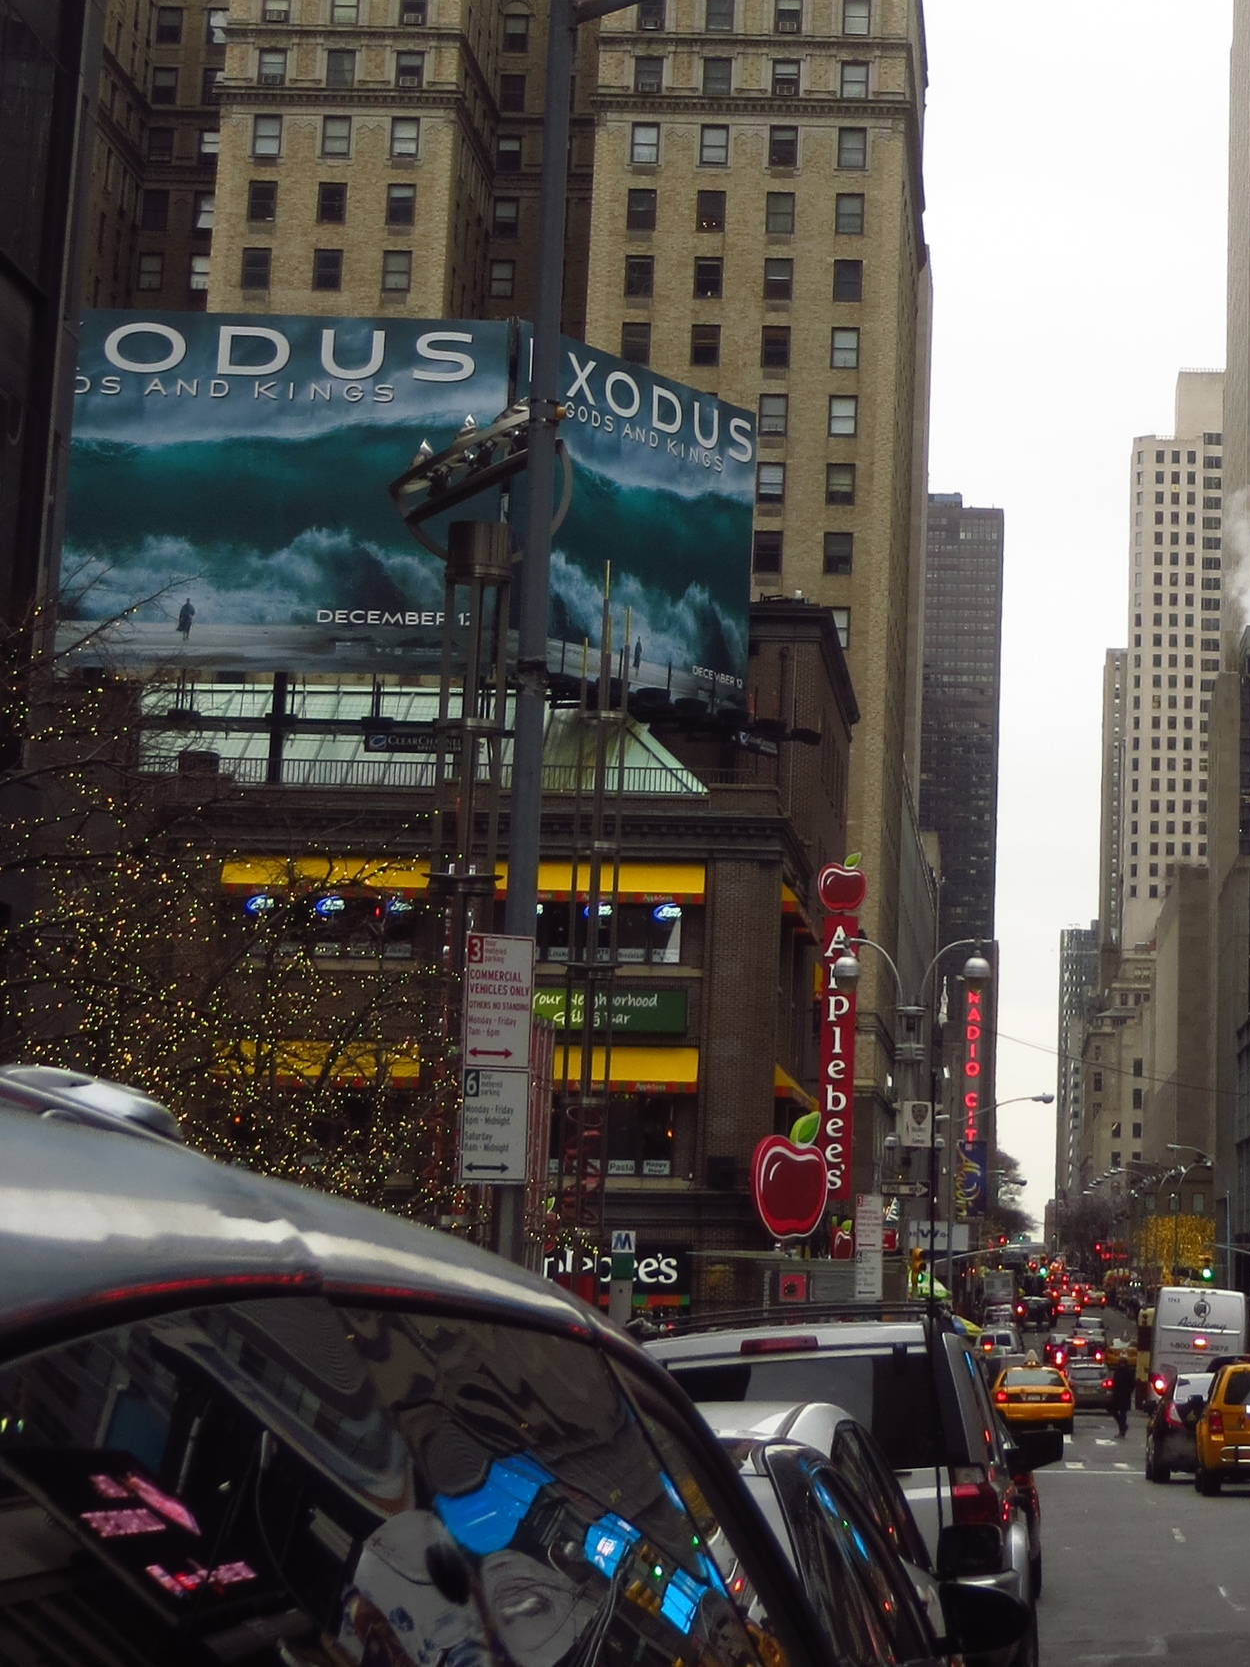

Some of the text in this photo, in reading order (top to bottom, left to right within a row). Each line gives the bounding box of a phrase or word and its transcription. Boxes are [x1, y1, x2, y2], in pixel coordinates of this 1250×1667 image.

[76, 321, 476, 383] ODUS
[144, 378, 231, 398] AND
[253, 380, 396, 403] KINGS
[529, 338, 753, 464] XODUS
[565, 401, 724, 473] GODS AND KINGS
[692, 664, 736, 685] DECEMBER
[470, 937, 482, 962] 3
[469, 968, 523, 984] COMMERCIAL
[469, 983, 531, 998] VEHICLES ONLY
[468, 1000, 531, 1013] OTHERS NO STANDING
[468, 1014, 517, 1028] Monday Friday
[964, 990, 982, 1144] RADIO CIT
[465, 1071, 478, 1096] 6
[465, 1104, 515, 1116] Monday Friday
[484, 1117, 511, 1127] Midnight
[464, 1131, 493, 1142] Saturday
[483, 1143, 510, 1154] Midnight
[609, 1162, 635, 1172] Pasta
[1178, 1315, 1227, 1334] Academy
